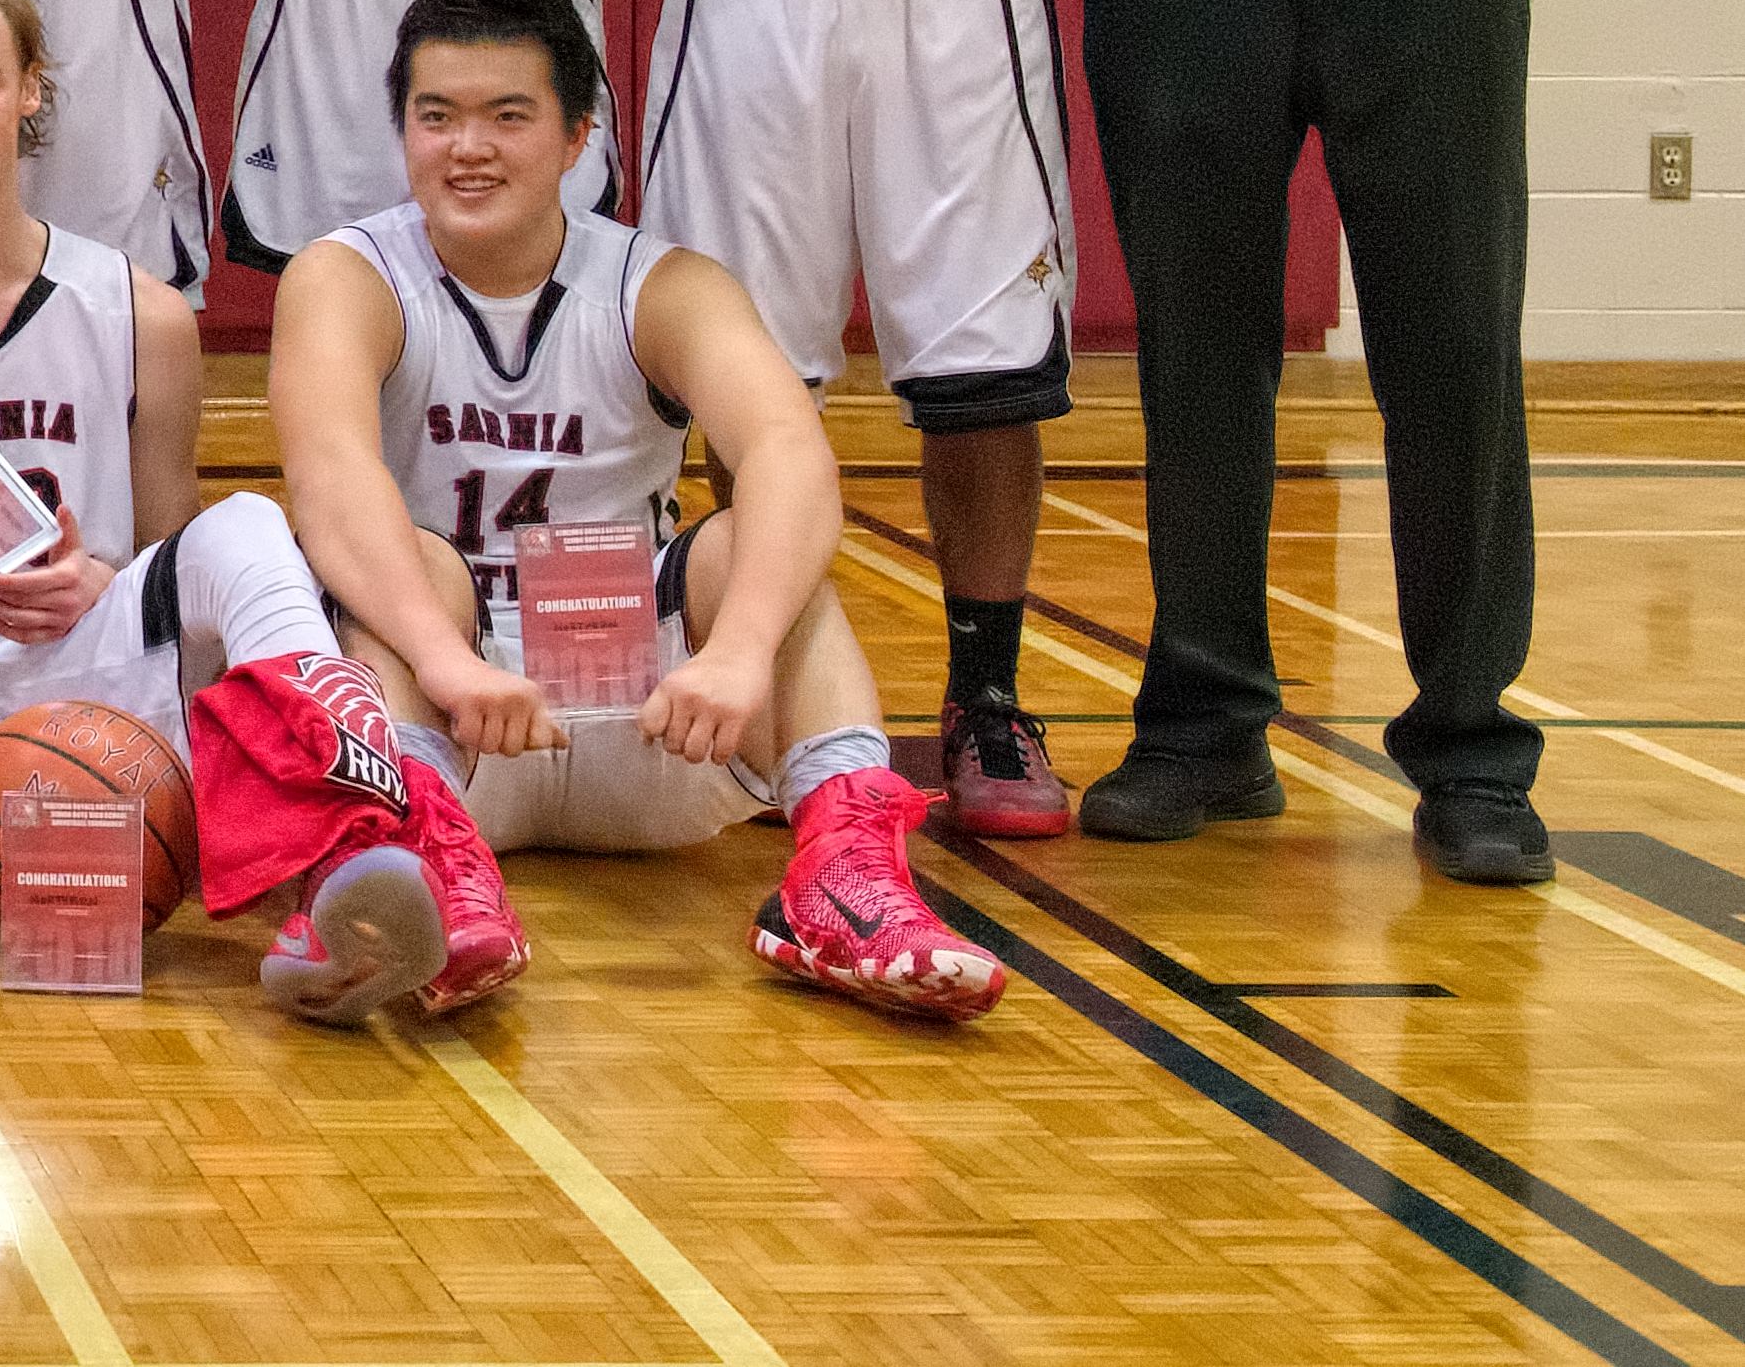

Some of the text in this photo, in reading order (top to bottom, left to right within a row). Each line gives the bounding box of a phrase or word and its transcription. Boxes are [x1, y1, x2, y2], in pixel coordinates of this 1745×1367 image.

[427, 403, 583, 455] SARNIA
[449, 469, 555, 554] 14
[536, 596, 641, 614] CONGRATULATIONS
[347, 743, 409, 805] ROY
[17, 872, 128, 888] CONGRATULATIONS
